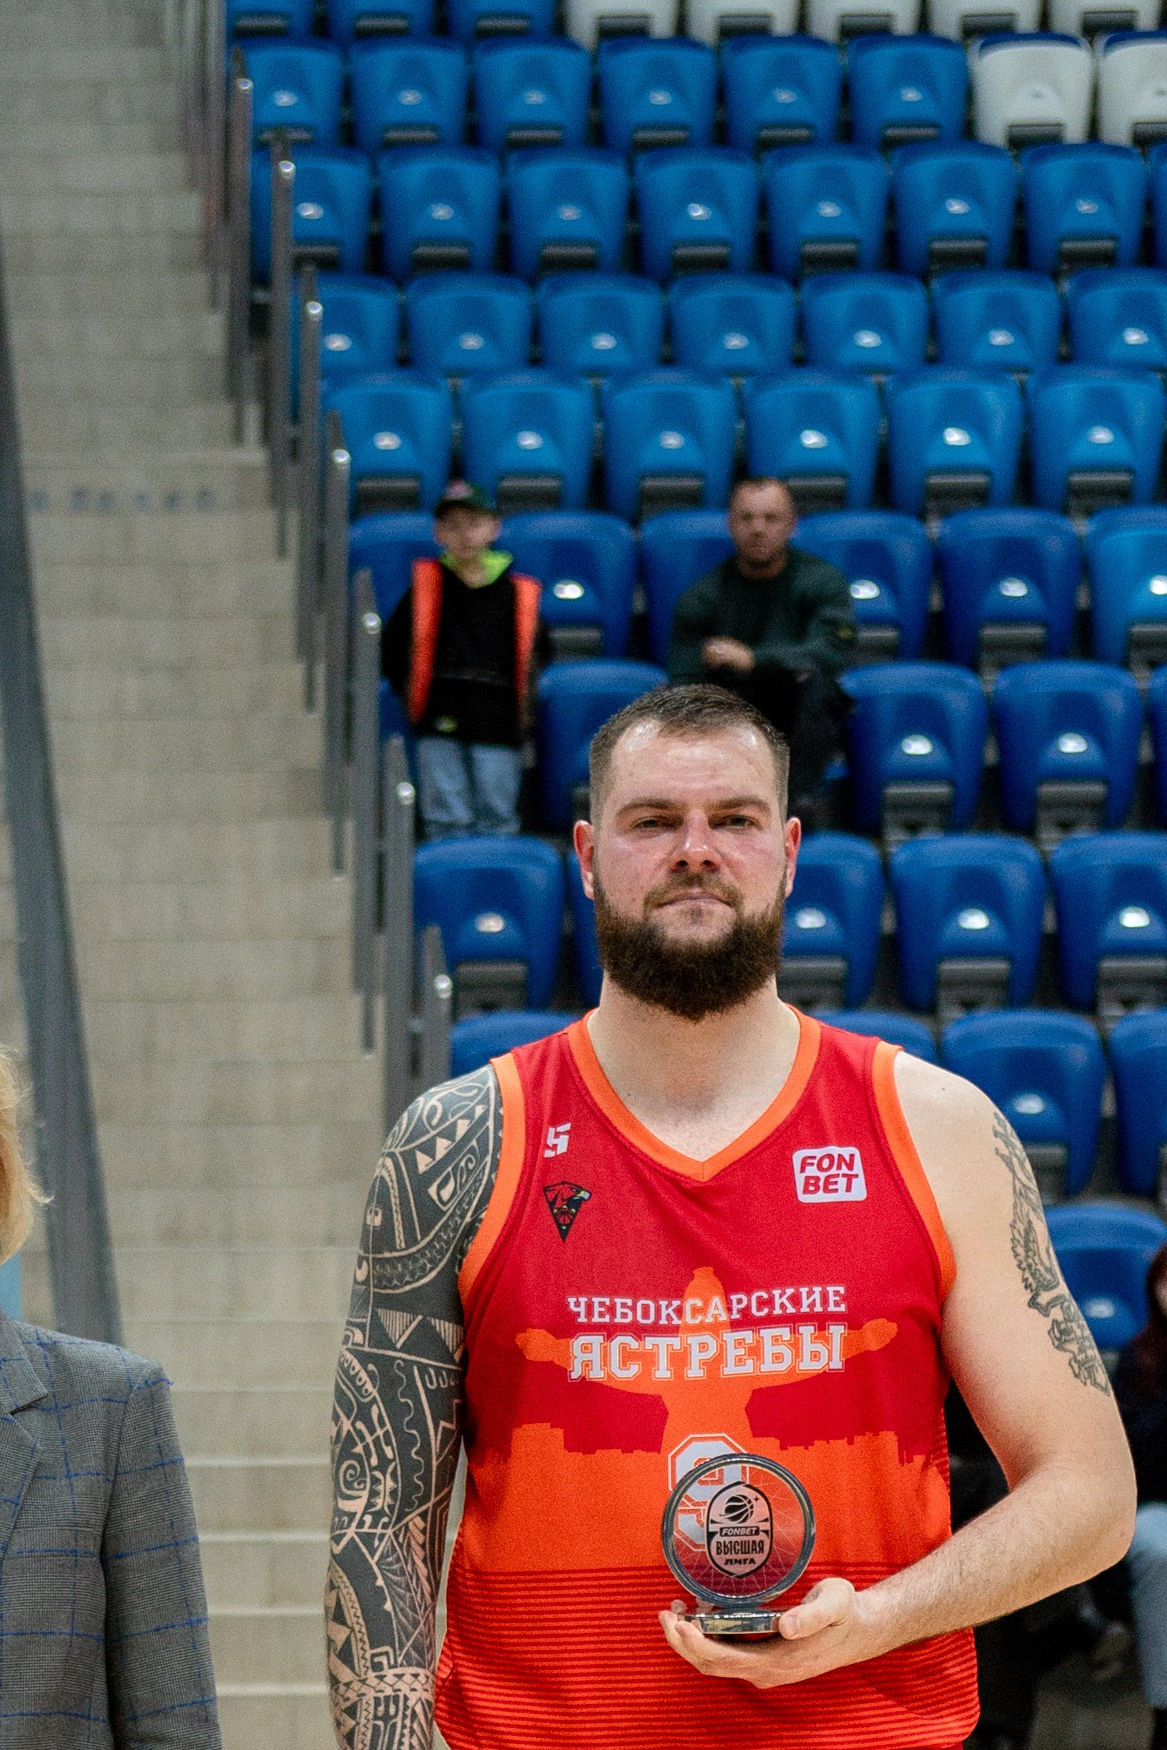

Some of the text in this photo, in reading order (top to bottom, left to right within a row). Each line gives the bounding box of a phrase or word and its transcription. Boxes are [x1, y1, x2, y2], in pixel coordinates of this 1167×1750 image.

[800, 1153, 855, 1173] FON
[802, 1172, 859, 1195] BET
[566, 1286, 847, 1326] ЧЕБОКСАРСКИЕ
[568, 1322, 848, 1382] ЯСТРЕБЫ
[721, 1527, 757, 1536] FONBET
[716, 1540, 765, 1556] ВЫСШАЯ
[724, 1558, 757, 1566] ЛИГА
